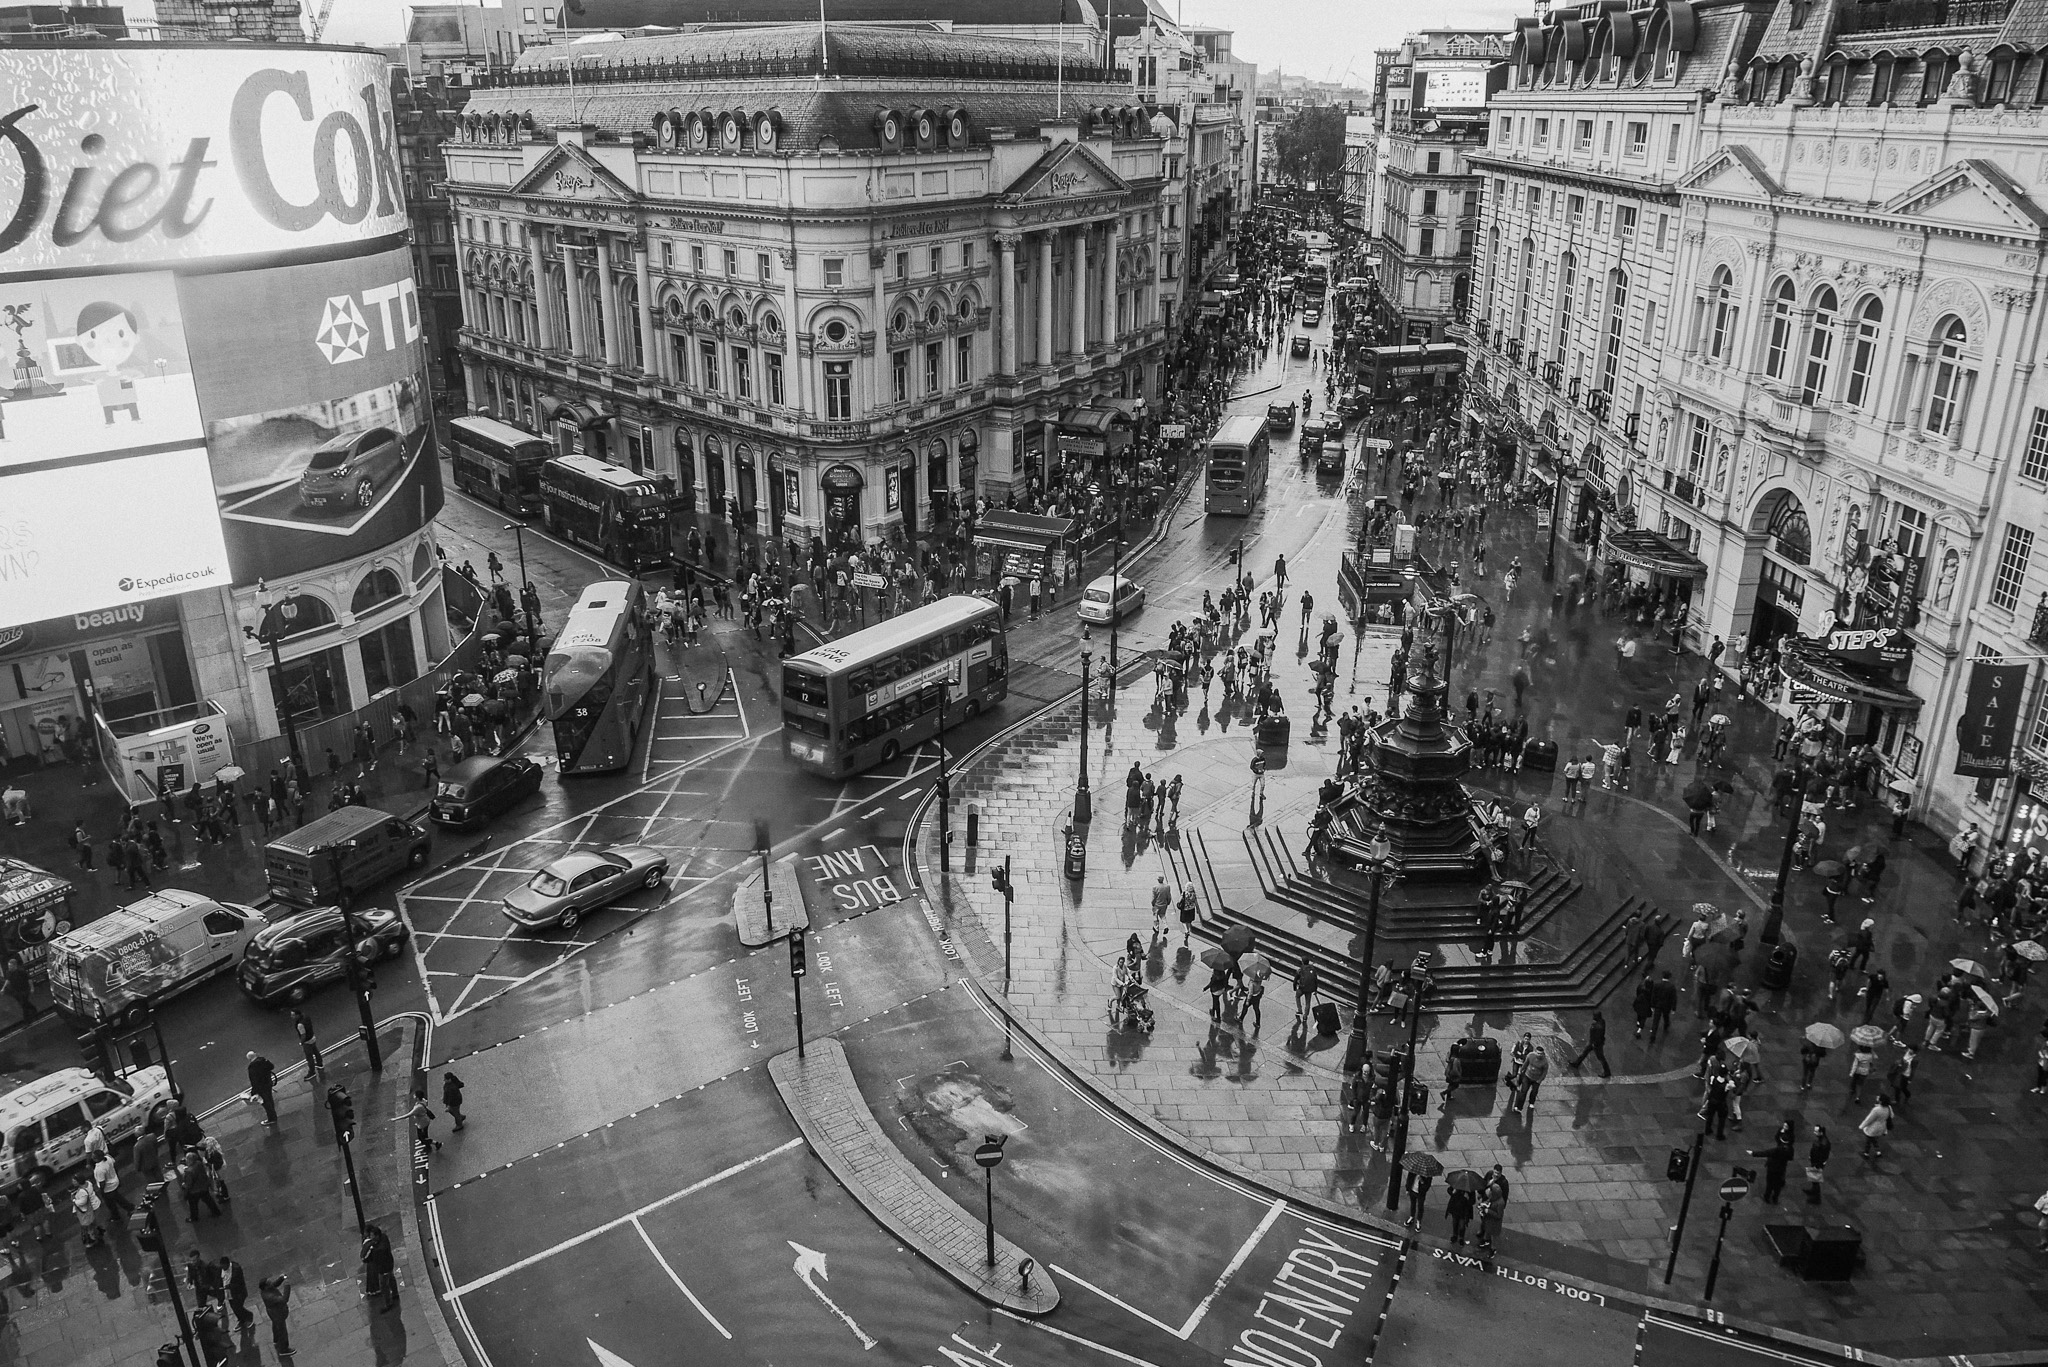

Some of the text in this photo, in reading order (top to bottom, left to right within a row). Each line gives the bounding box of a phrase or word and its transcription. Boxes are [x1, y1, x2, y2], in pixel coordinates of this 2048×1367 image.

[0, 104, 218, 254] Diet
[75, 603, 145, 631] beauty
[92, 642, 133, 657] open as
[1827, 628, 1898, 651] STEPS'
[94, 653, 123, 666] usual
[1812, 673, 1849, 693] THEATRE
[575, 708, 588, 717] 38
[1980, 675, 2003, 748] SALE
[194, 733, 214, 744] We're
[196, 737, 223, 750] open as
[197, 745, 216, 755] usual
[803, 844, 889, 882] LANE
[832, 875, 902, 910] BUS
[5, 908, 35, 923] HALF PRICE
[923, 909, 960, 961] LOOK RIGHT
[816, 951, 844, 1006] LOOK LEFT
[736, 978, 759, 1034] LOOK LEFT
[1254, 1227, 1380, 1350] ENTRY
[1432, 1248, 1606, 1307] LOOK BOTH WAYS
